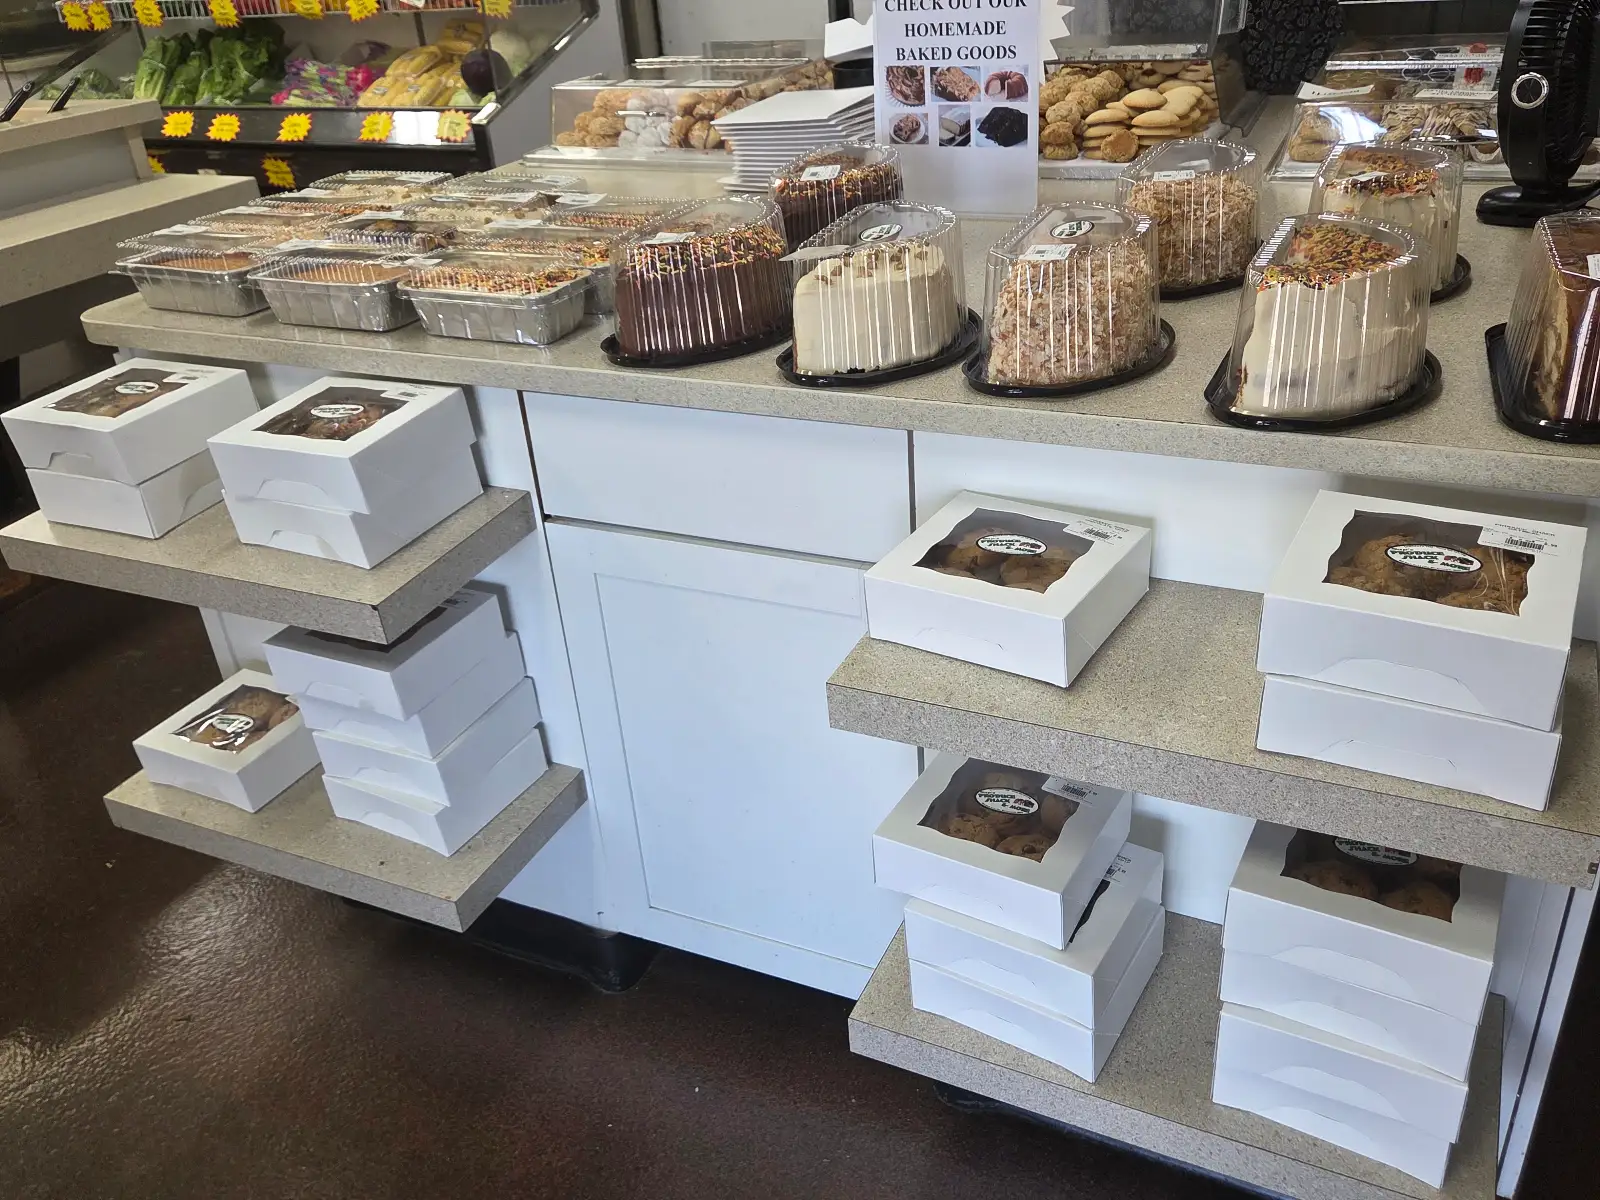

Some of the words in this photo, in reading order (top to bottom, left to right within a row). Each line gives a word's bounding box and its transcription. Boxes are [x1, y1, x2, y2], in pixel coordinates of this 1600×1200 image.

[885, 0, 944, 12] CHECK
[948, 0, 982, 9] OUT
[988, 0, 1027, 8] OUR
[904, 20, 1007, 37] HOMEMADE
[896, 46, 952, 61] BAKED
[957, 45, 1017, 60] GOODS
